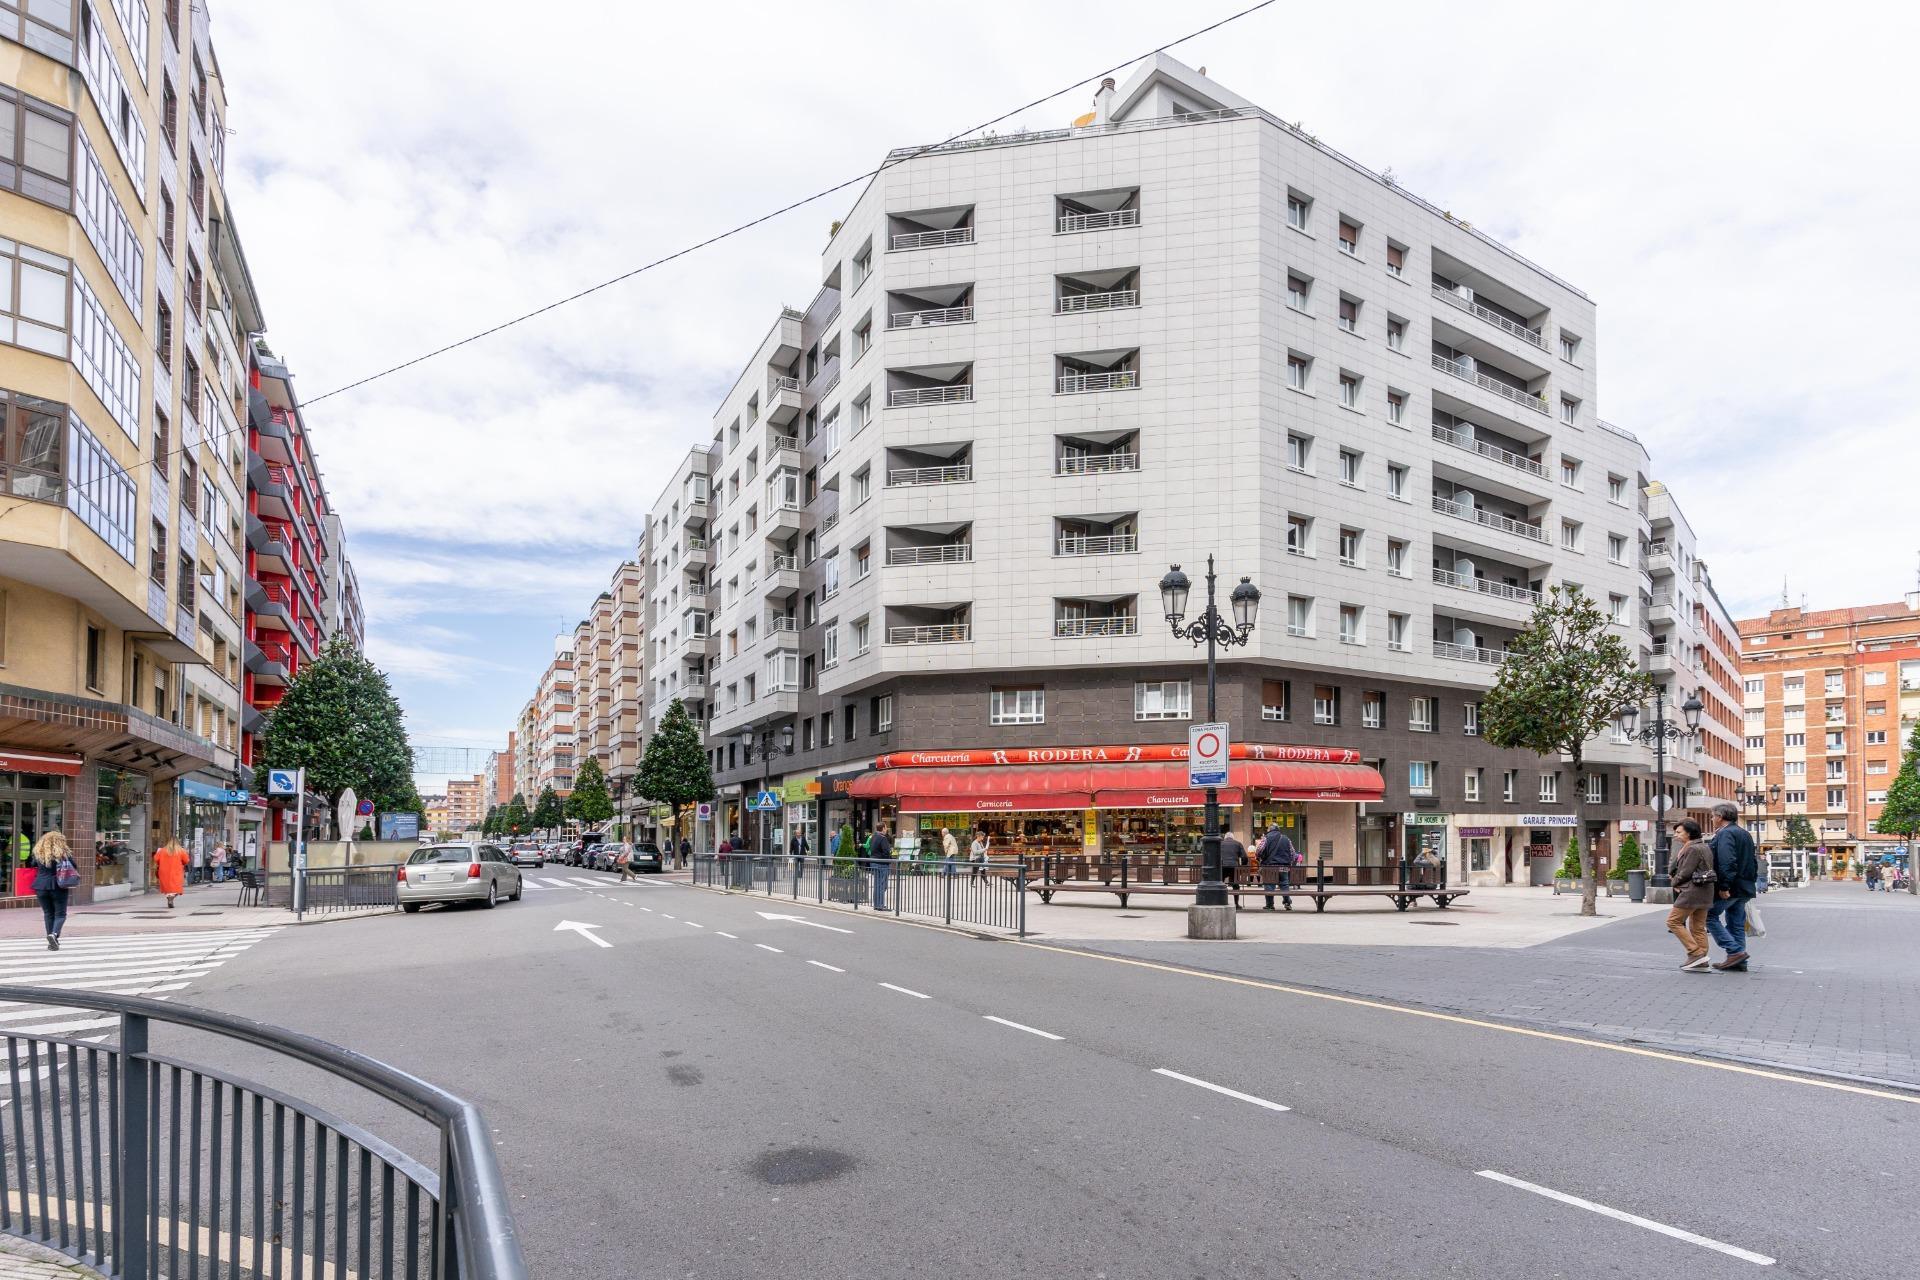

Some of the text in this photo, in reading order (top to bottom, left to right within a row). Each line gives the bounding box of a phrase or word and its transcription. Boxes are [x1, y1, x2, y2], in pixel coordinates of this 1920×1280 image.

[1027, 749, 1108, 762] RODERA
[1278, 747, 1330, 760] RODERA
[1523, 816, 1546, 825] GARAJE
